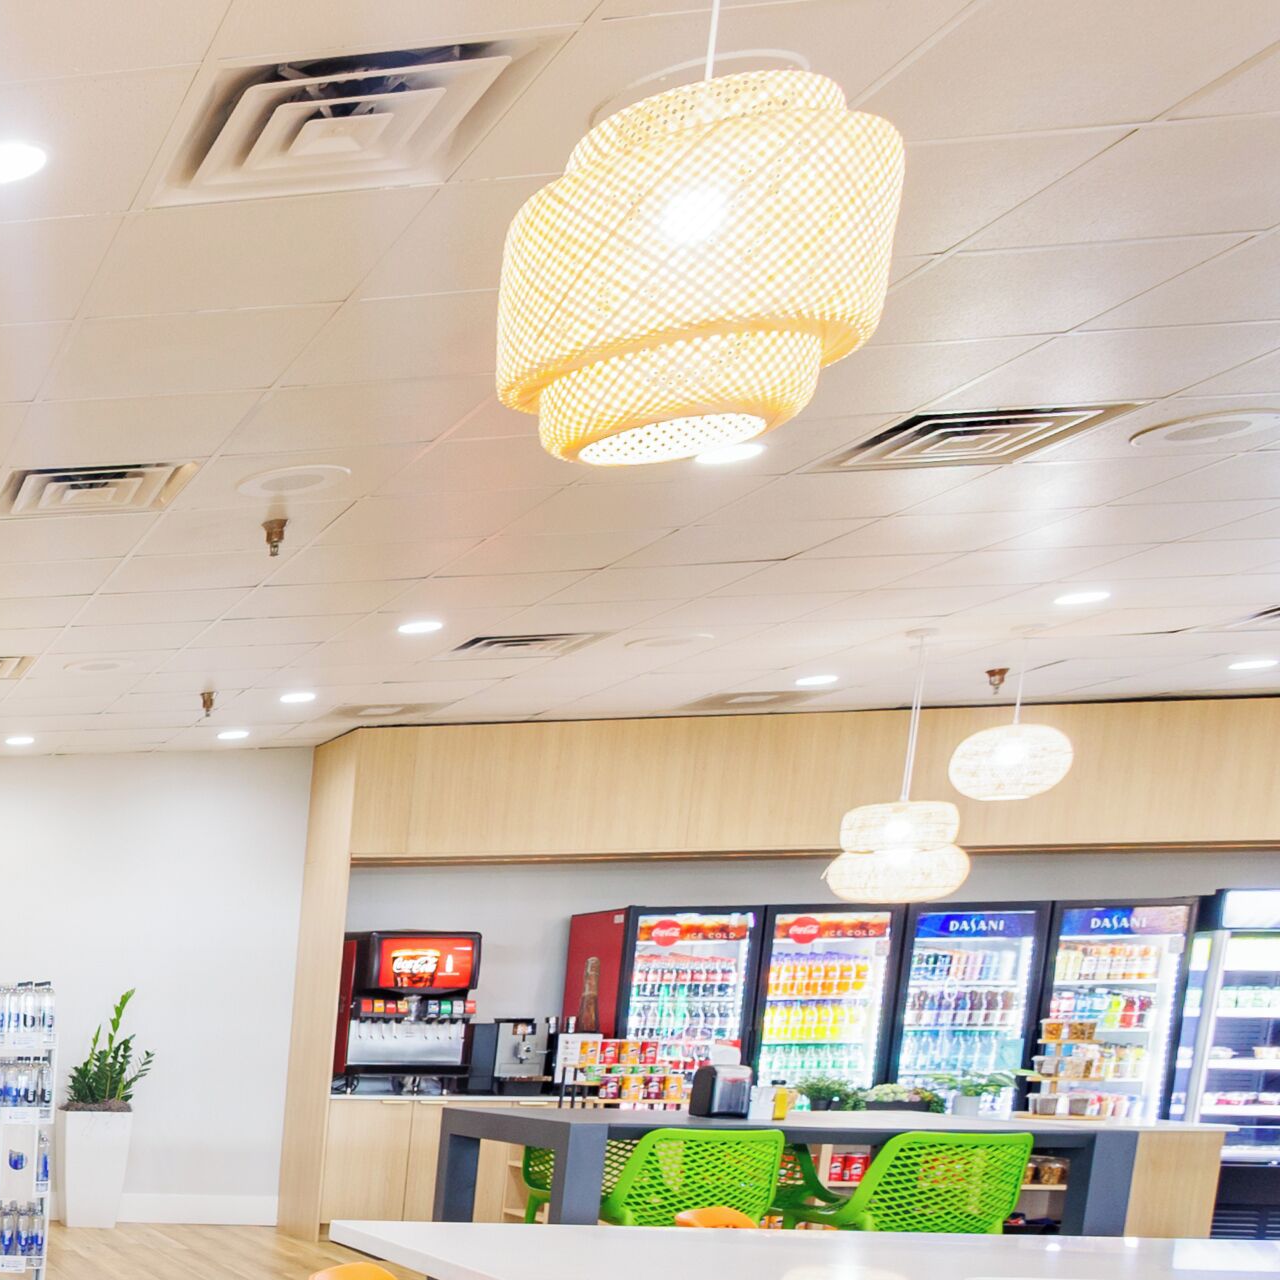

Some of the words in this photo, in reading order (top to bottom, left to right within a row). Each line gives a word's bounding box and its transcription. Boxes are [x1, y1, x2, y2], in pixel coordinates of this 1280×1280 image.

[949, 918, 1004, 933] DASANI
[1091, 915, 1146, 930] DASANI
[651, 927, 680, 937] Coca-Cola
[789, 925, 818, 935] Coca-Cola
[847, 929, 876, 937] COLD
[392, 956, 438, 974] Coca-Cola
